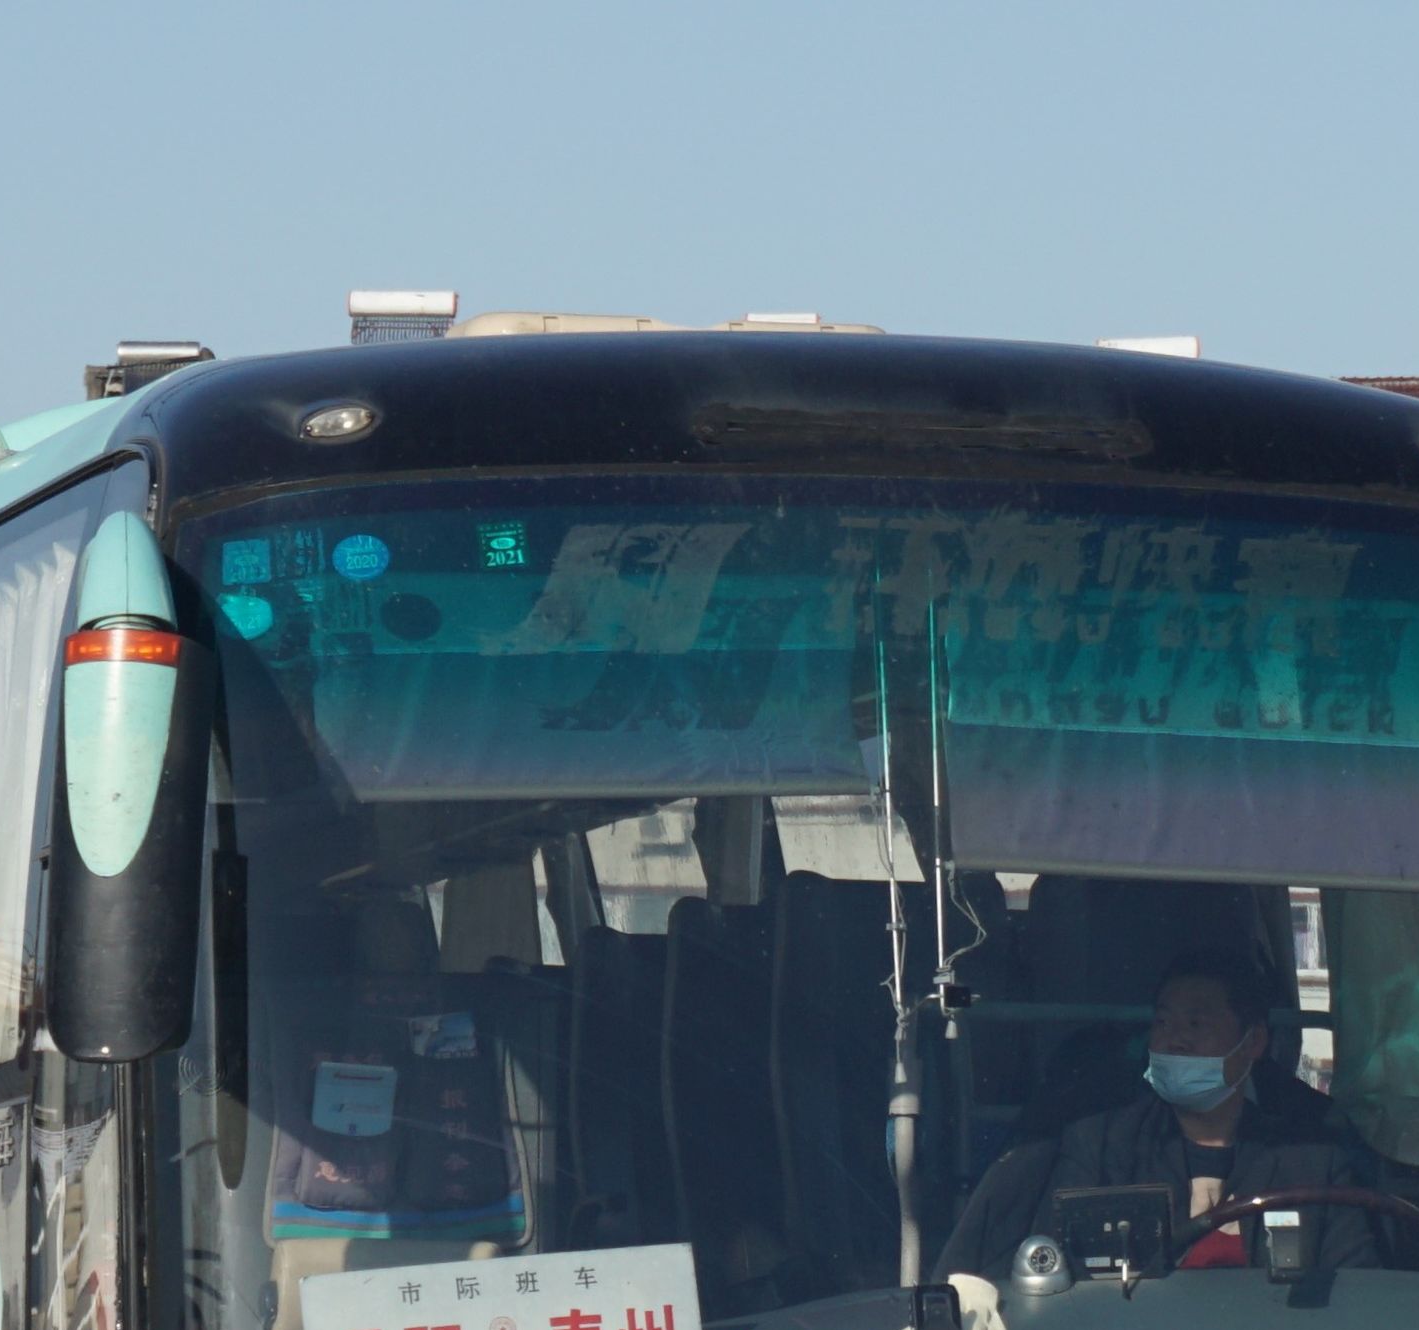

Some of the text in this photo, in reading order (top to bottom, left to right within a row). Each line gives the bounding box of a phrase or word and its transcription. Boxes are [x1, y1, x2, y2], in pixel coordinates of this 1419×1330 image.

[346, 554, 378, 569] 2020
[486, 550, 525, 567] 2021
[398, 1266, 598, 1306] 市际班车
